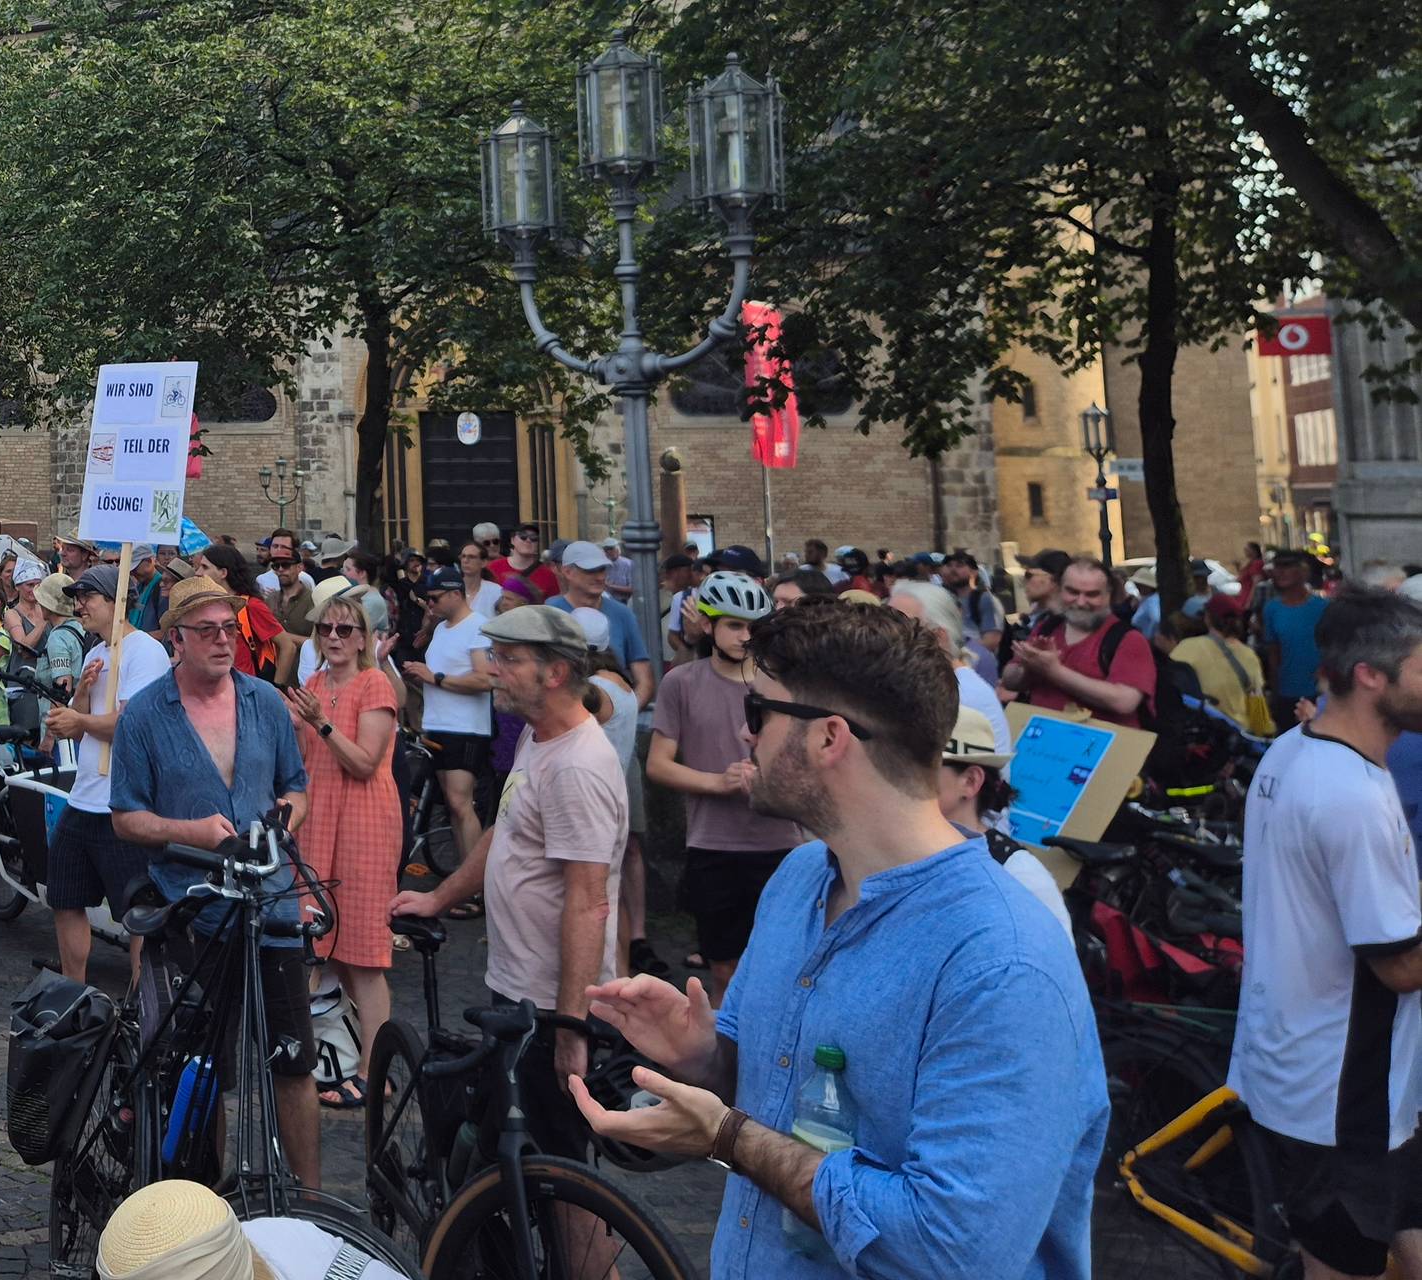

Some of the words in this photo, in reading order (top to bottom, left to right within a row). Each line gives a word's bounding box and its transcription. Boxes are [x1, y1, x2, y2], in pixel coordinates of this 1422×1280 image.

[106, 383, 125, 397] WIR
[129, 383, 153, 397] SIND
[124, 438, 144, 453] TEIL
[148, 438, 170, 453] DER
[97, 492, 143, 512] LÖSUNG!
